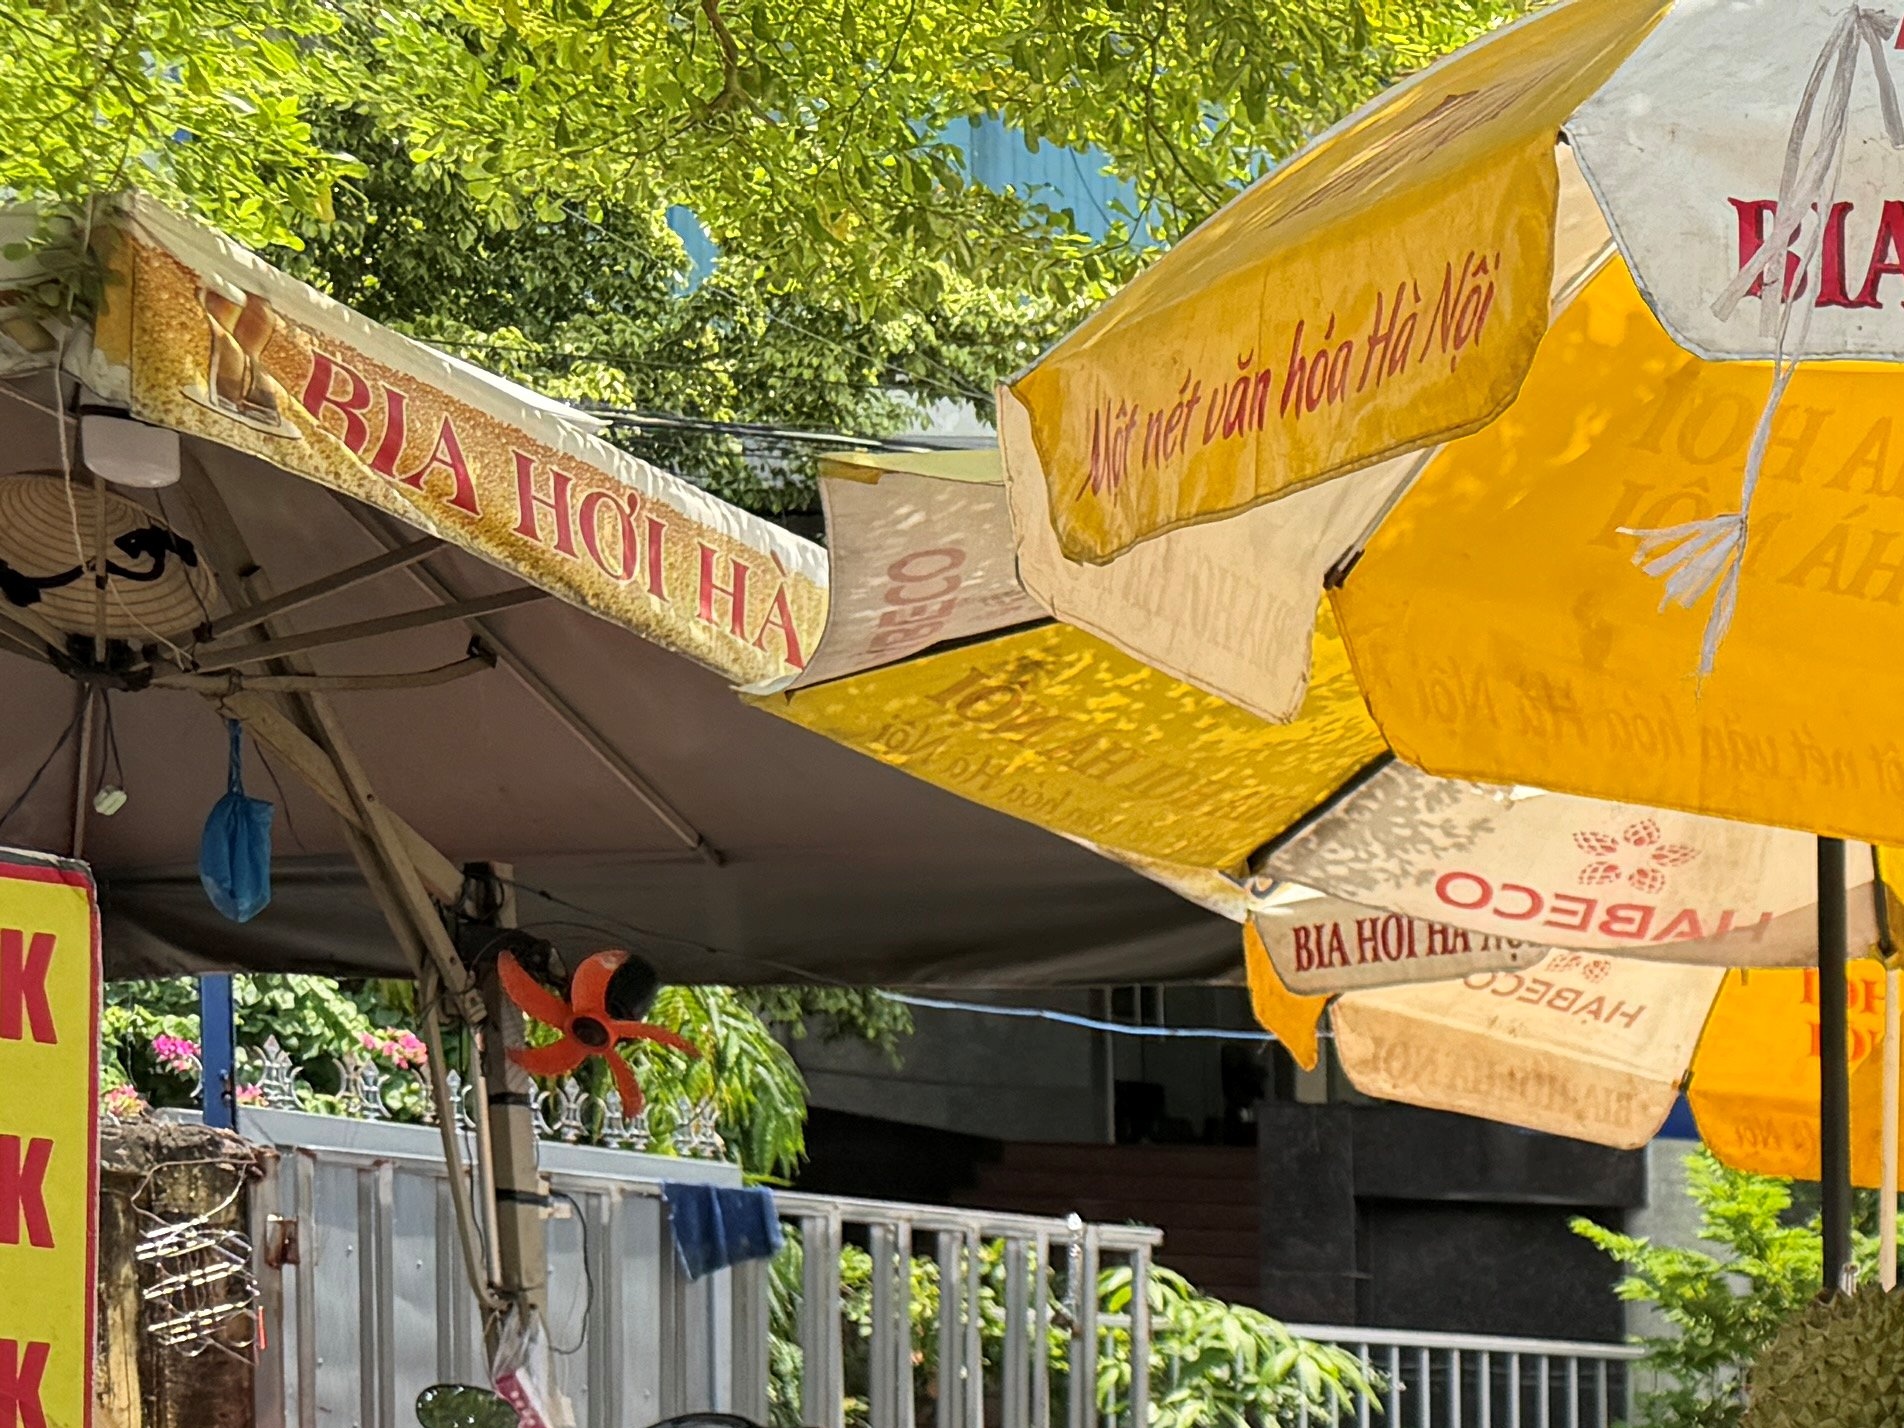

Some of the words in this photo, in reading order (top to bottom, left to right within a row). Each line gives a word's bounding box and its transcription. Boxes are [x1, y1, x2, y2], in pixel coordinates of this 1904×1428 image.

[1075, 398, 1138, 508] Một
[1142, 369, 1201, 470] nét
[1202, 348, 1271, 446] văn
[1280, 312, 1354, 421] hóa
[1356, 279, 1421, 394] Hà
[1418, 250, 1500, 373] Nội
[303, 350, 482, 517] BIA
[511, 448, 668, 603] HƠI
[697, 550, 804, 670] HÀ
[1292, 920, 1351, 972] BIA
